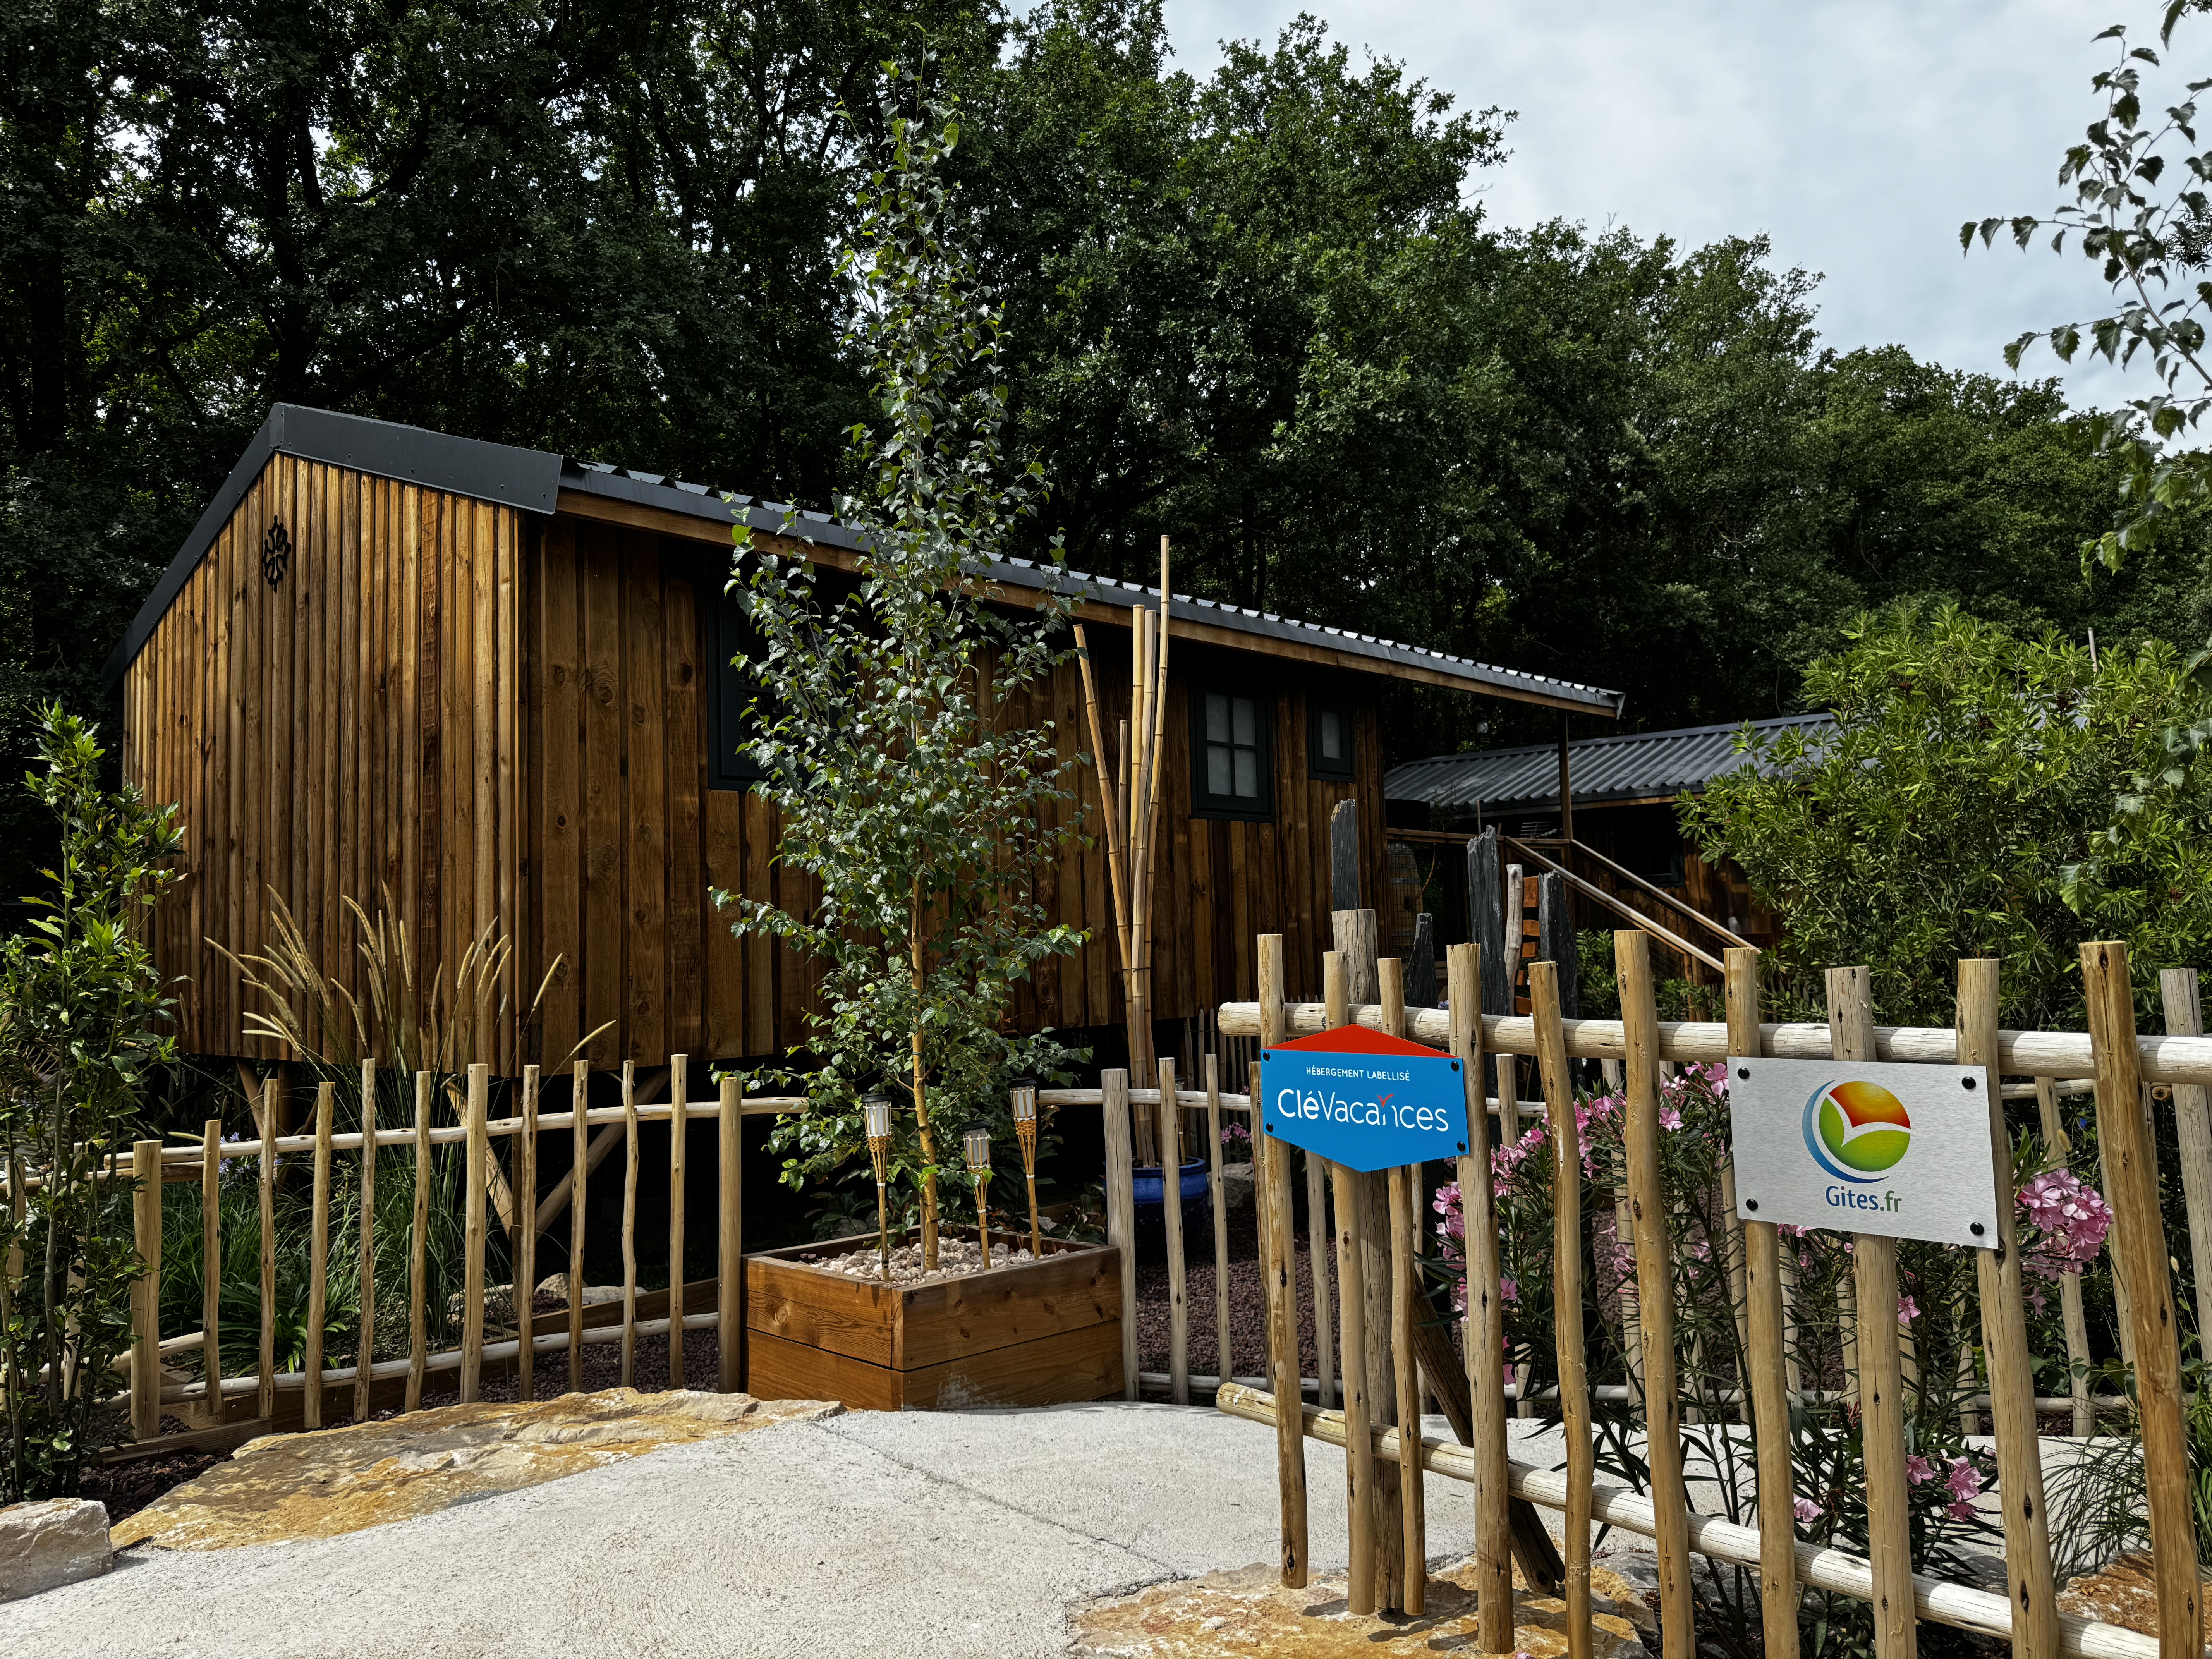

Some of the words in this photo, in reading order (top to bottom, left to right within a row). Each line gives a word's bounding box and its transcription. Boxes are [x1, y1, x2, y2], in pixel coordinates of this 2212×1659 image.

[1306, 1065, 1364, 1079] HÉBERGEMENT
[1367, 1070, 1410, 1082] LABELLISÉ
[1825, 1185, 1902, 1213] Gites.fr
